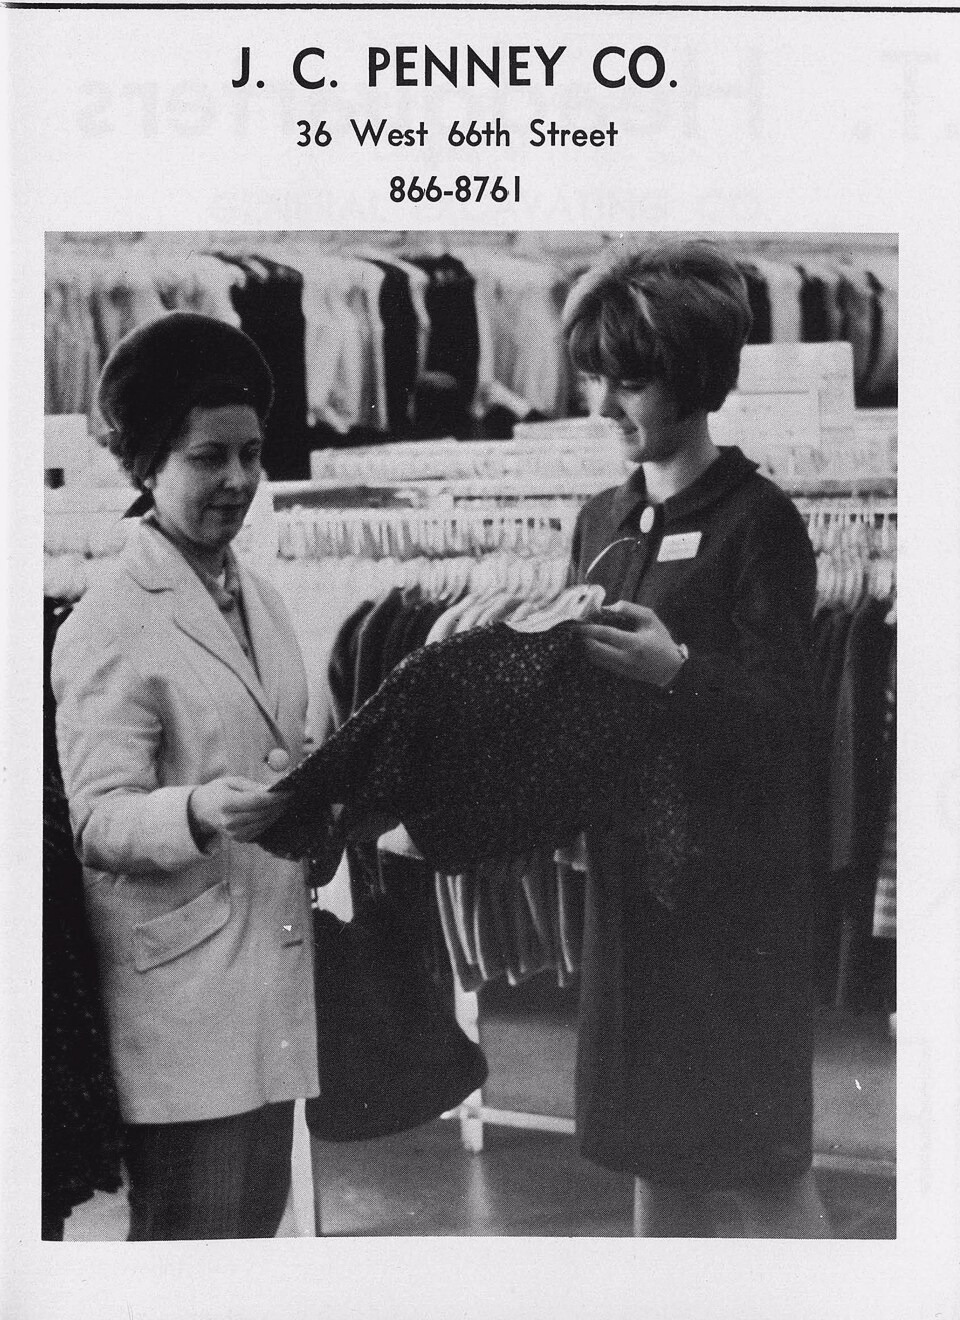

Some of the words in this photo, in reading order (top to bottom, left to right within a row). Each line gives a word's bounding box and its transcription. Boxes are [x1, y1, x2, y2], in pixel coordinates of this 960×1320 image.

[232, 47, 264, 88] J.
[293, 47, 337, 89] C.
[369, 45, 566, 88] PENNEY
[593, 46, 677, 88] CO.
[297, 120, 332, 147] 36
[350, 119, 428, 146] West
[448, 118, 509, 146] 66th
[530, 119, 618, 147] Street
[390, 176, 519, 203] 866-8761
